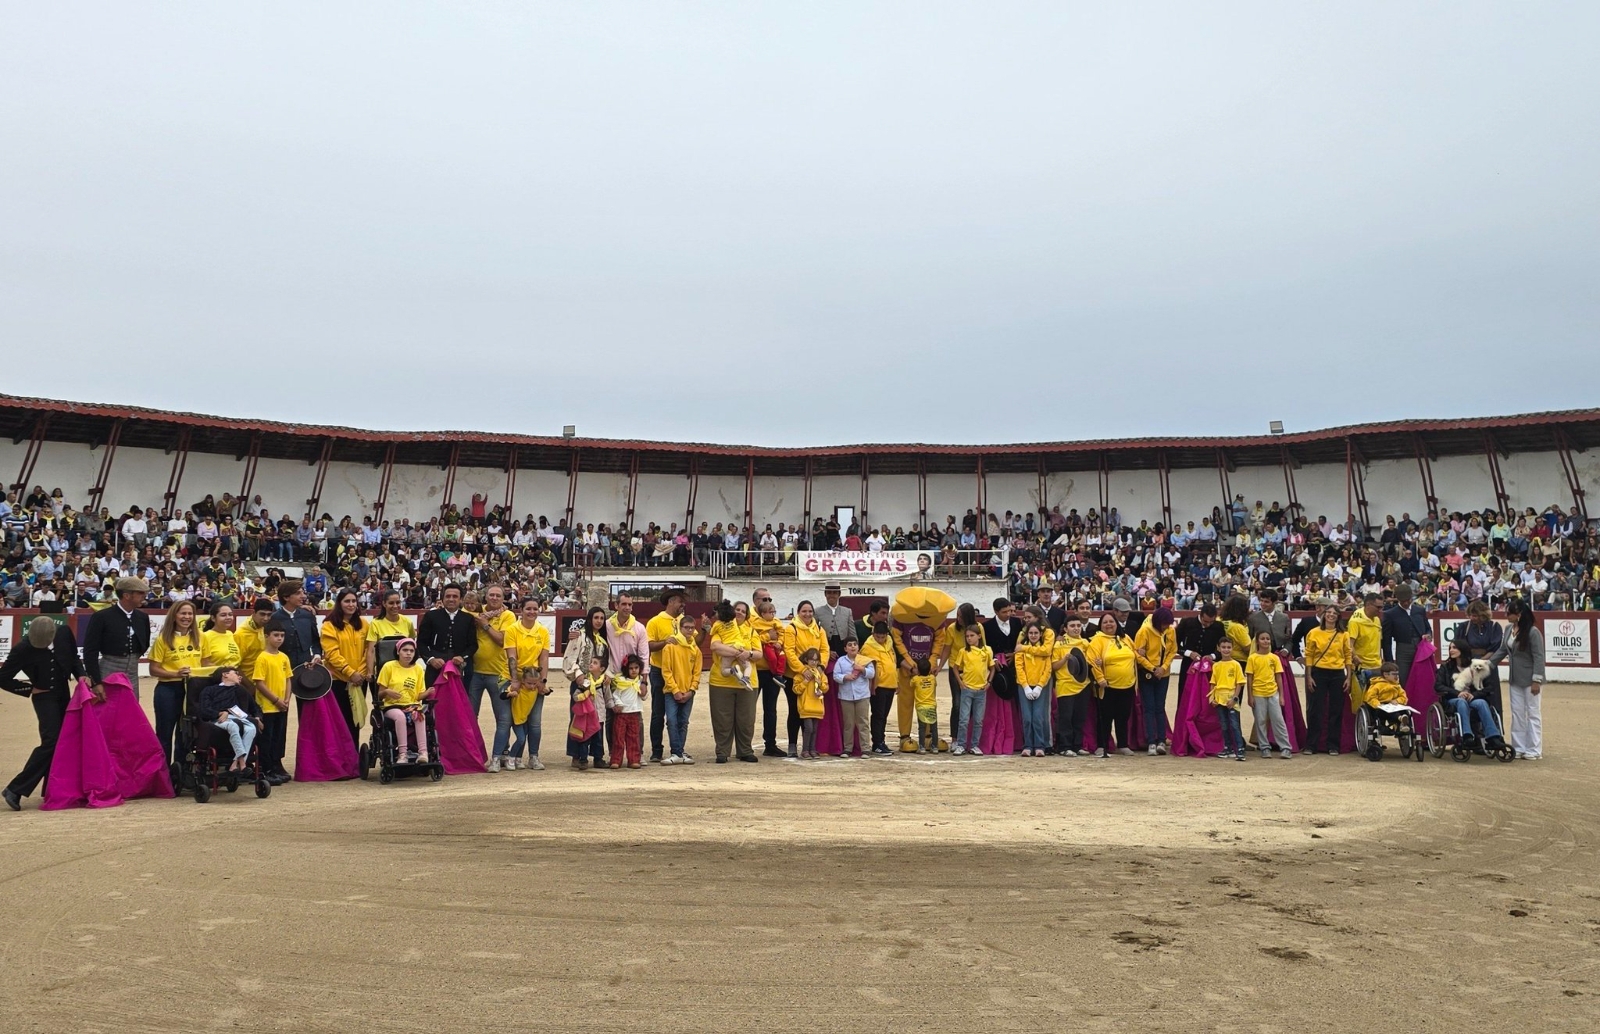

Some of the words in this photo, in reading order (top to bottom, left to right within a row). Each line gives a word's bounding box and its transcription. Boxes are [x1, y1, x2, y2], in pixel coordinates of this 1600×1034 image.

[805, 559, 908, 572] GRACIAS
[848, 587, 876, 595] TORILES
[1553, 636, 1582, 647] MULAS
